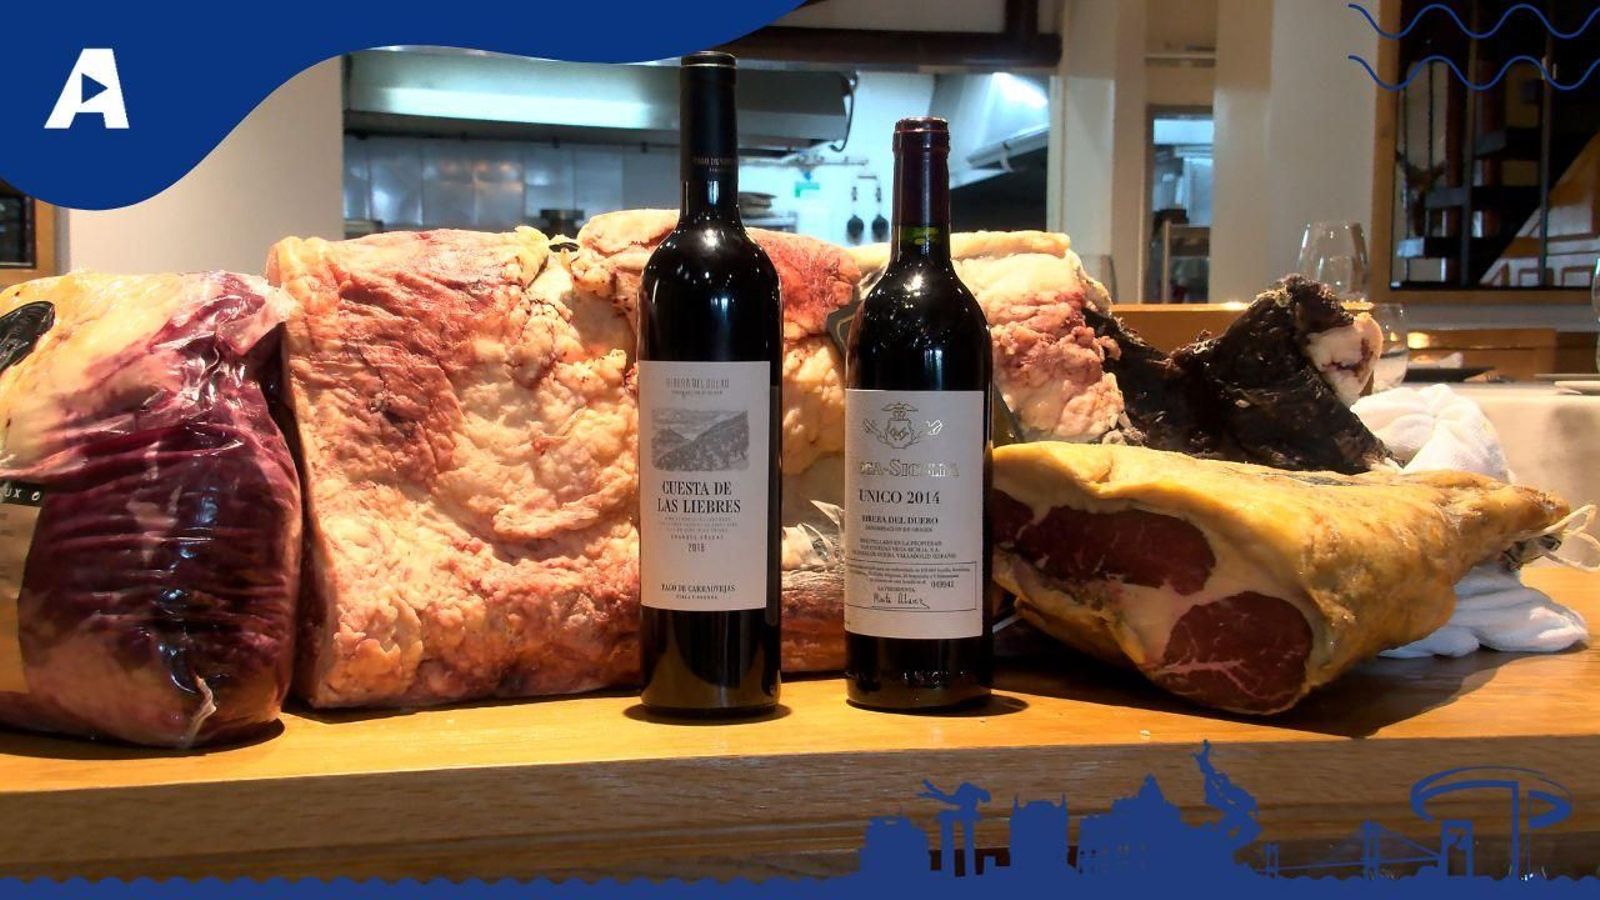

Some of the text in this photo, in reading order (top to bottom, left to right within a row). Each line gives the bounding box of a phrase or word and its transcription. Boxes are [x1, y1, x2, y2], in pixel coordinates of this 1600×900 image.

[662, 480, 732, 496] CUESTA DE
[859, 489, 941, 504] UNICO 2014
[657, 498, 741, 514] LAS LIEBRES
[888, 516, 906, 525] DEL
[907, 516, 939, 525] DUERO
